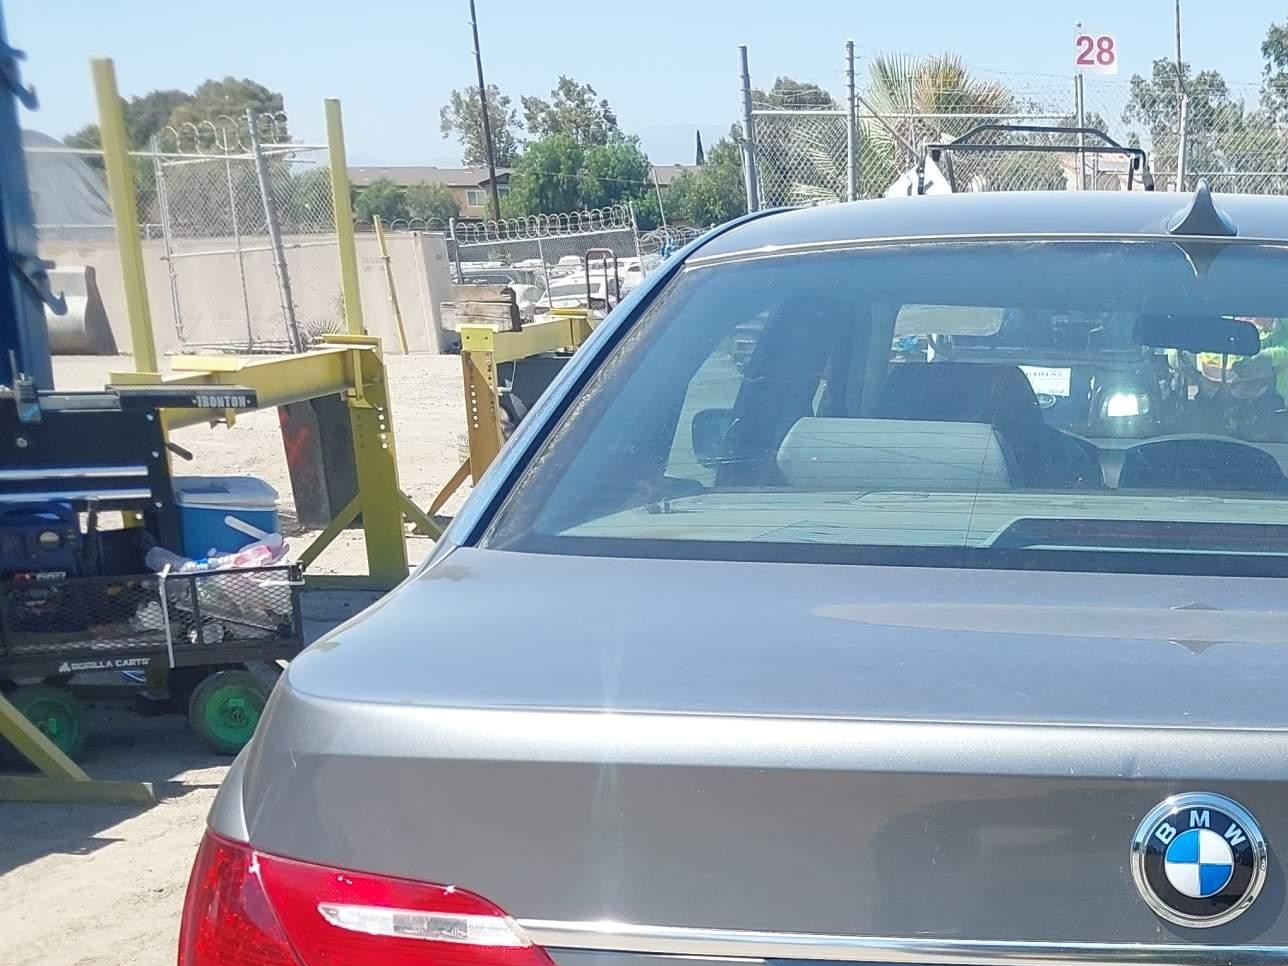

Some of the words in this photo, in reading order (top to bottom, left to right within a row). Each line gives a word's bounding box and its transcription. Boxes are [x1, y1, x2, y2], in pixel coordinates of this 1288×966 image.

[1076, 36, 1115, 66] 28
[196, 395, 247, 408] IRONTON
[1155, 809, 1247, 846] BMW
